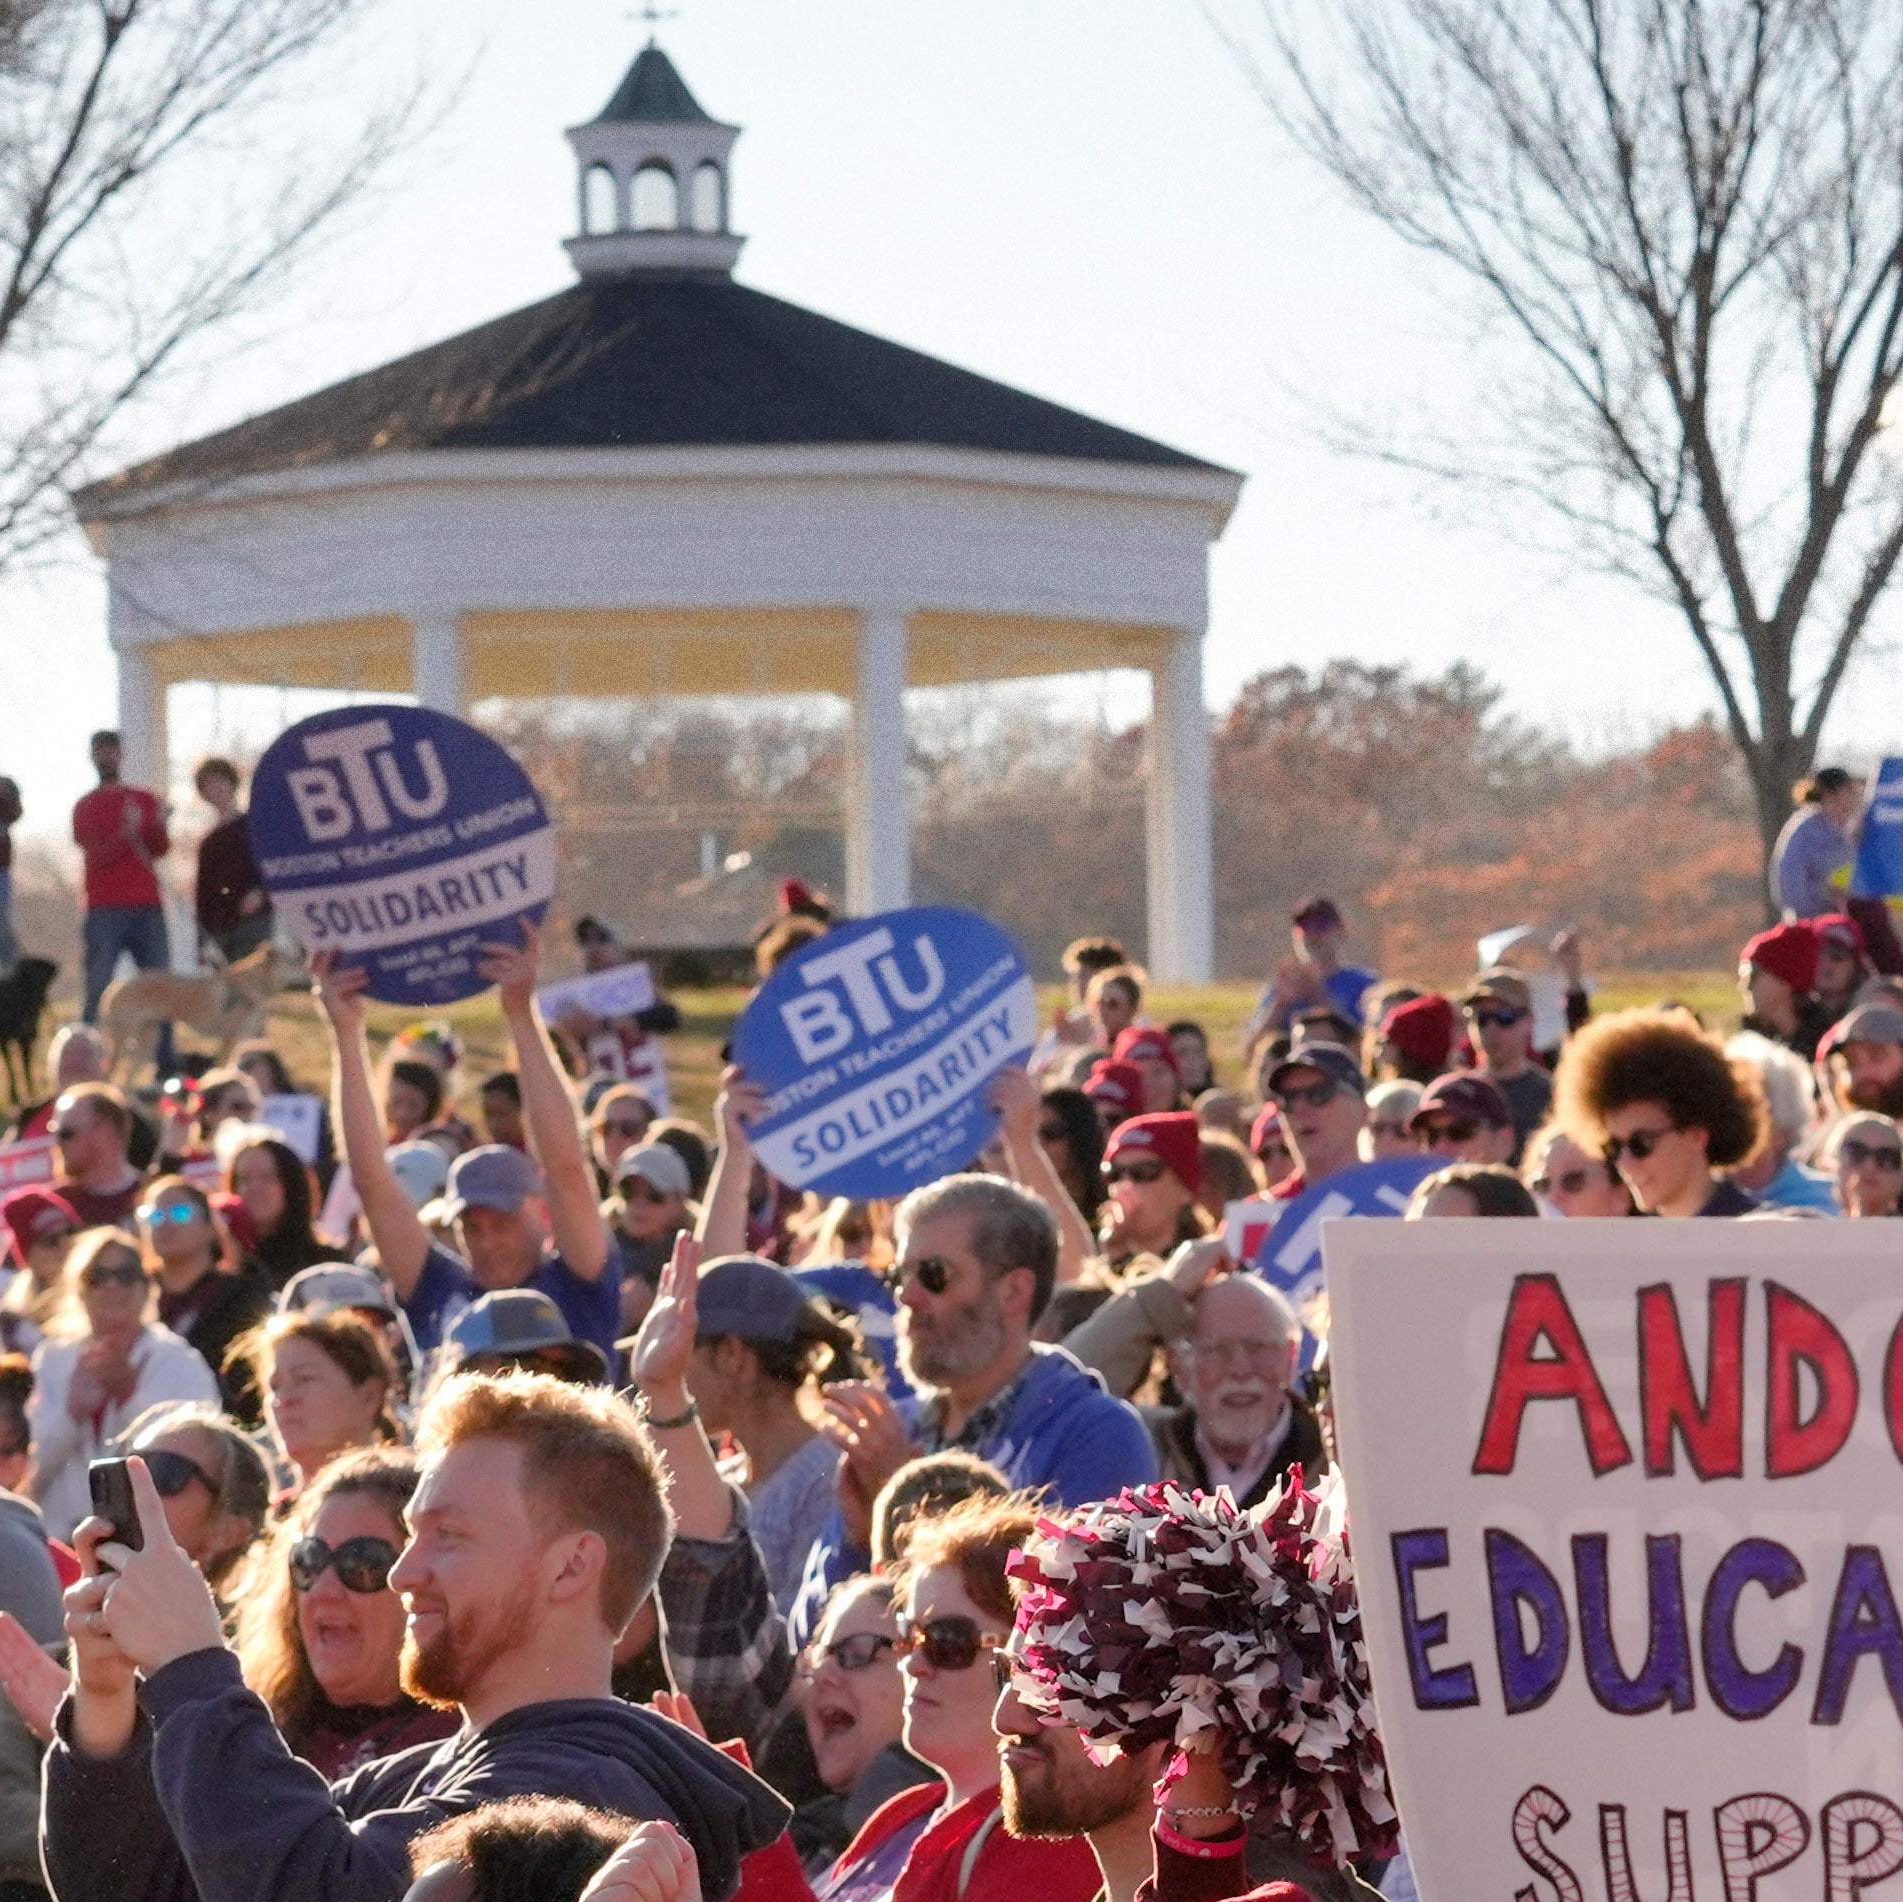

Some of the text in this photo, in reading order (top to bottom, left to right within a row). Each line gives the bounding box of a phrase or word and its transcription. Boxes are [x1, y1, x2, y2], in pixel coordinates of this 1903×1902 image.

[287, 719, 448, 844] BTU
[305, 853, 528, 938] SOLIDARITY
[779, 927, 946, 1064] BTU
[793, 1006, 1013, 1169] SOLIDARITY
